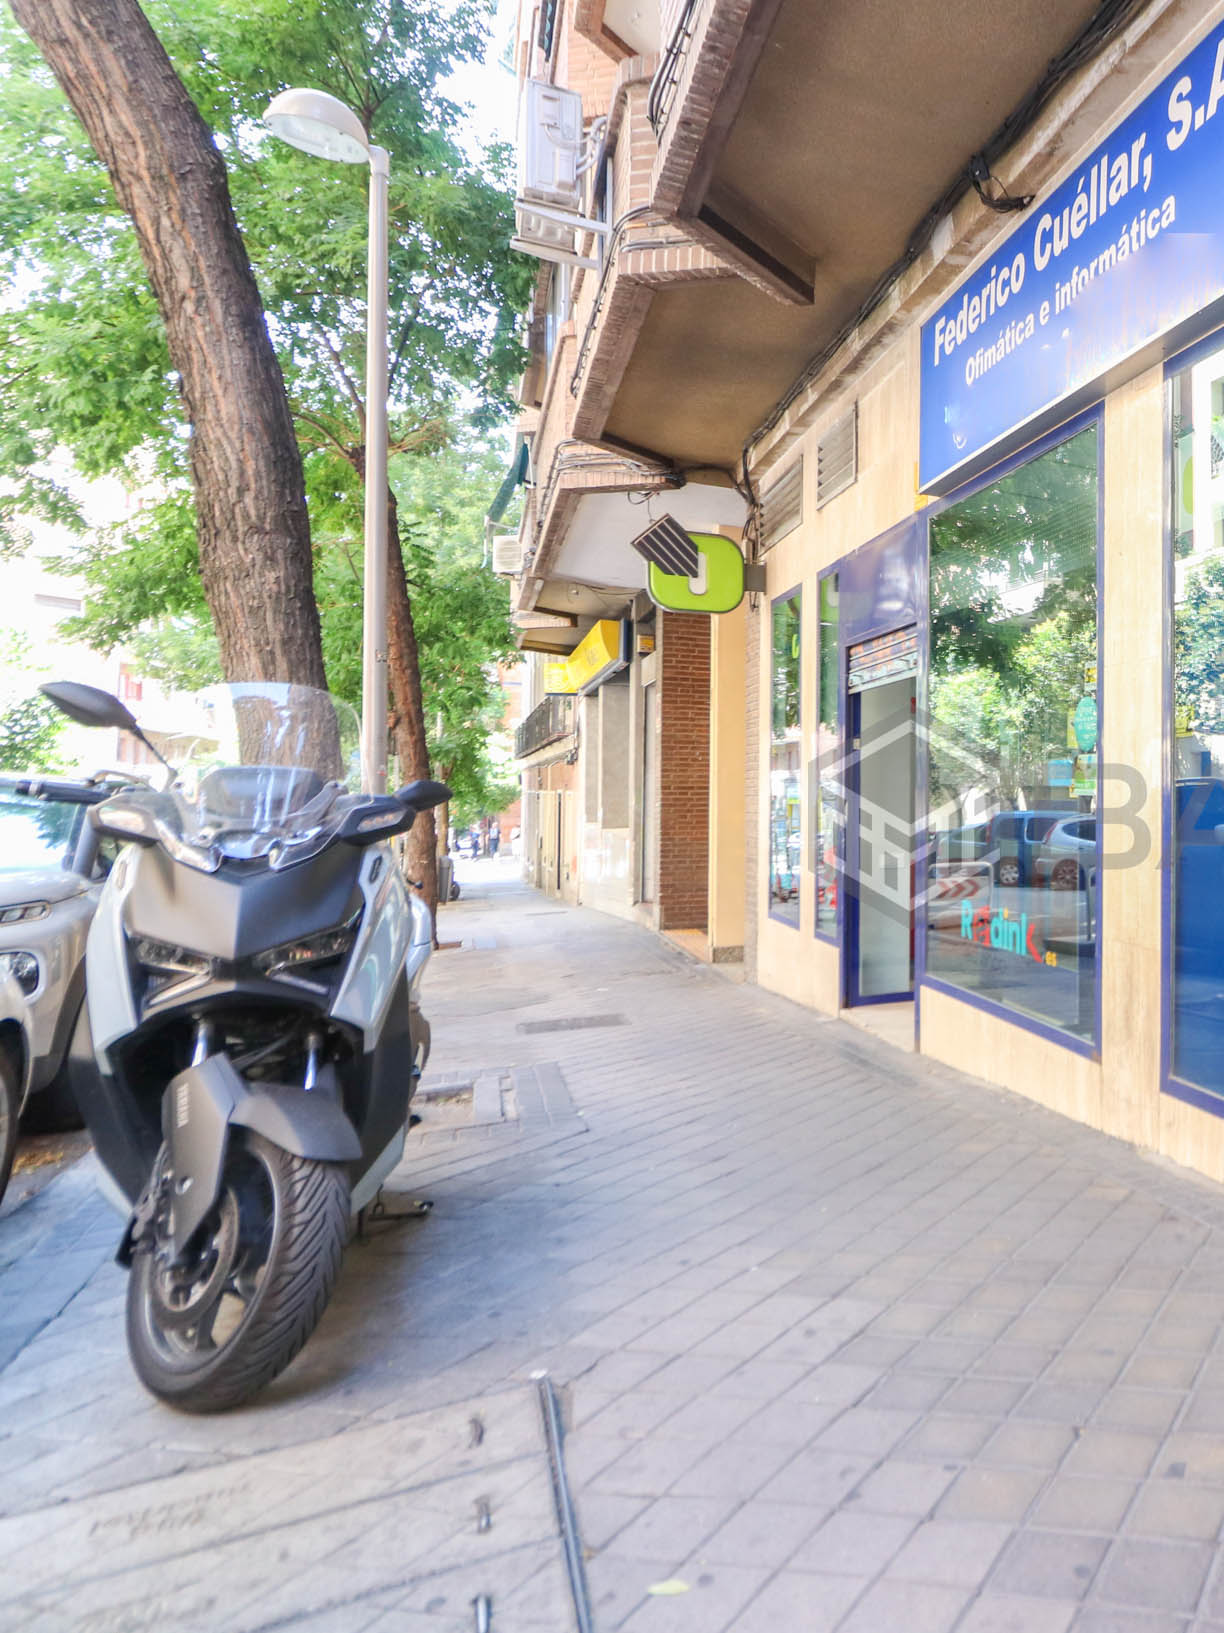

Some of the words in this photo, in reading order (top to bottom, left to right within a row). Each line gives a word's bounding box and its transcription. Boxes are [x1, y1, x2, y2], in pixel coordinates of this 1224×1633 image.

[934, 253, 1025, 367] Federico
[1034, 132, 1153, 271] Cuéllar,
[965, 313, 1035, 386] Ofimática
[1040, 300, 1051, 326] e
[1055, 195, 1177, 315] informática
